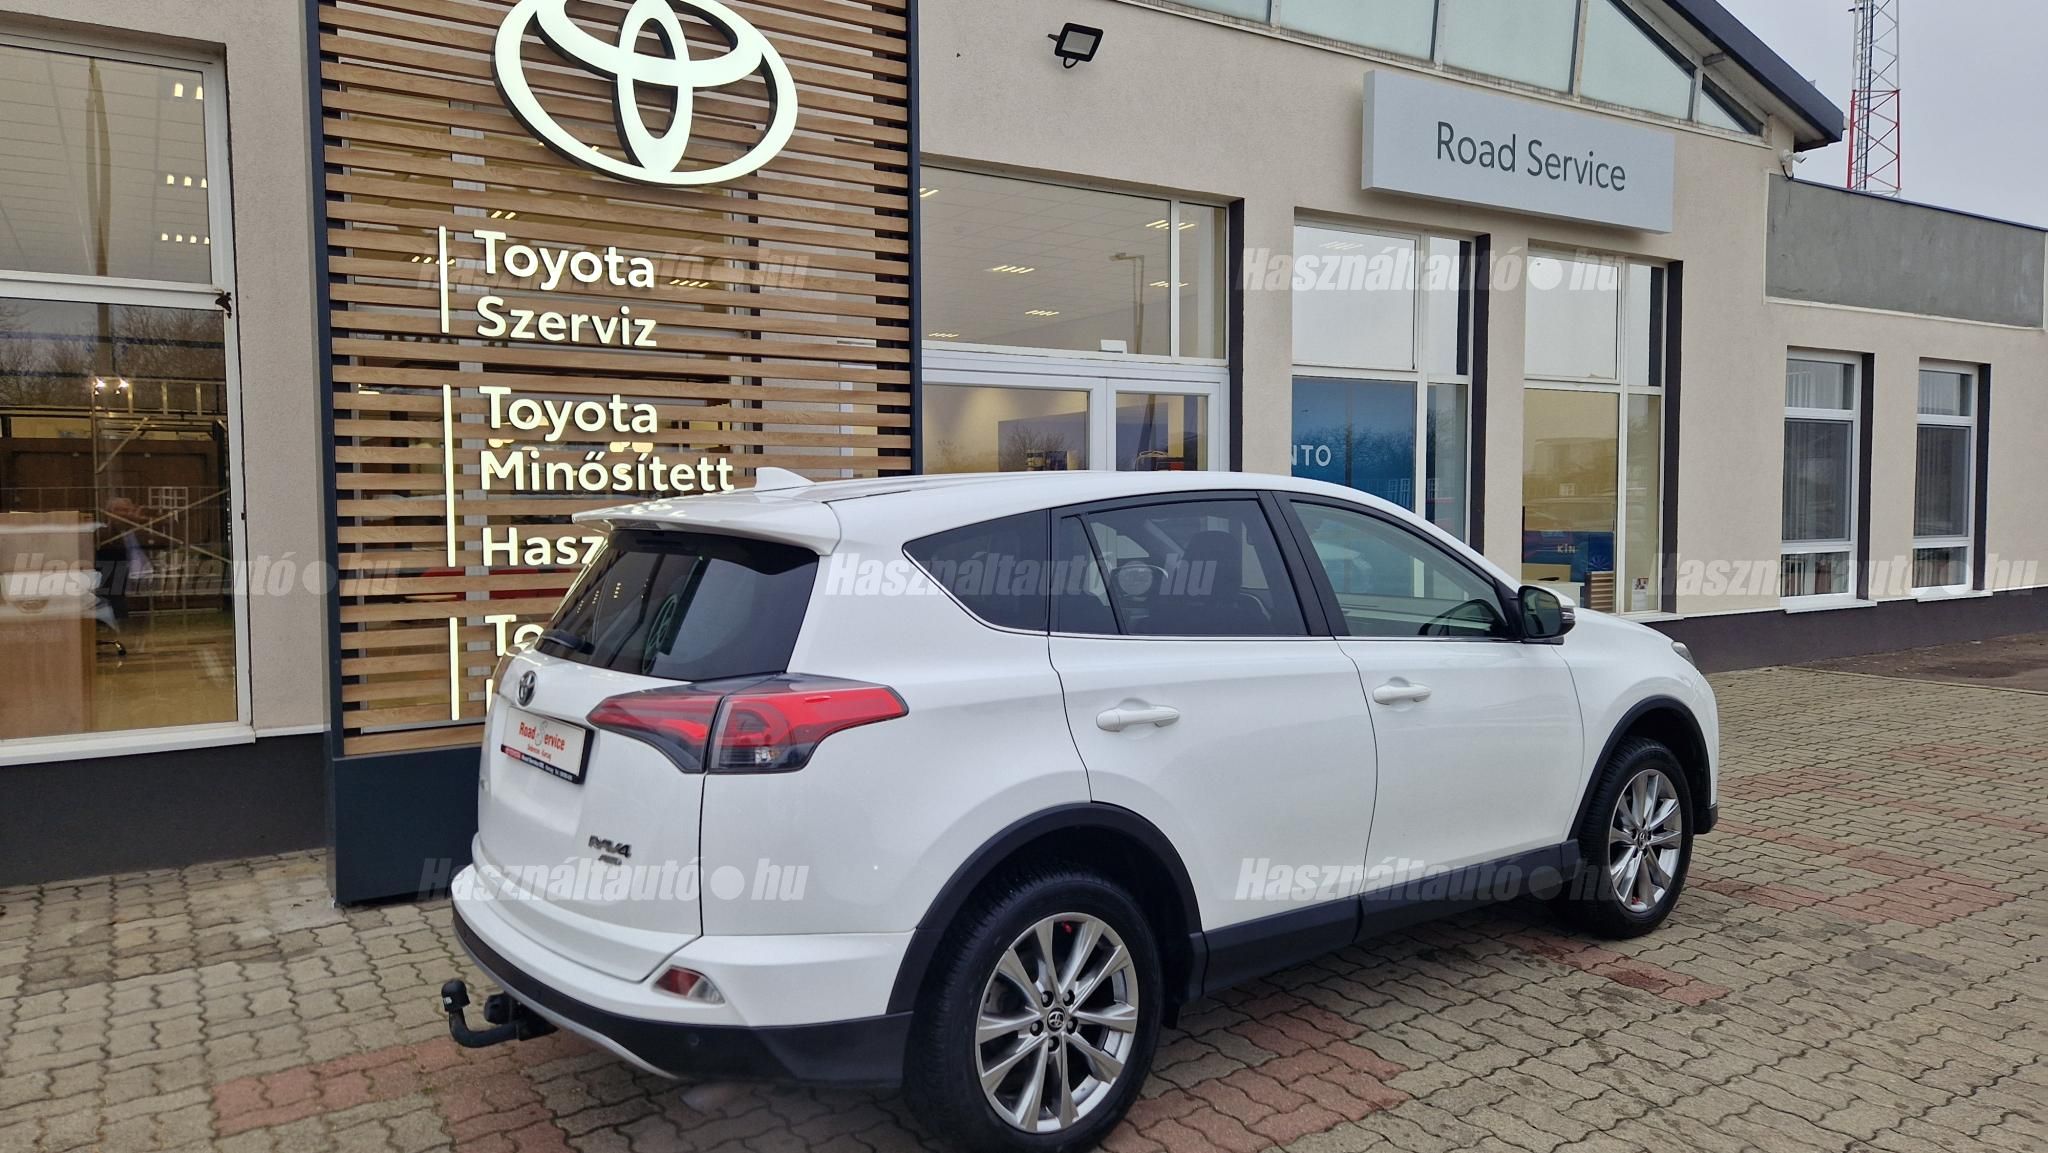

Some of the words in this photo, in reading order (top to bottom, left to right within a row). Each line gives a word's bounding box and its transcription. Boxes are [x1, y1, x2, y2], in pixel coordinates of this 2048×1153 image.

[1437, 121, 1516, 172] Road
[1527, 139, 1626, 192] Service
[473, 229, 656, 290] Toyota
[475, 296, 658, 347] Szerviz
[479, 386, 658, 442] Toyota
[480, 450, 735, 491] Minősített
[519, 721, 537, 740] Road
